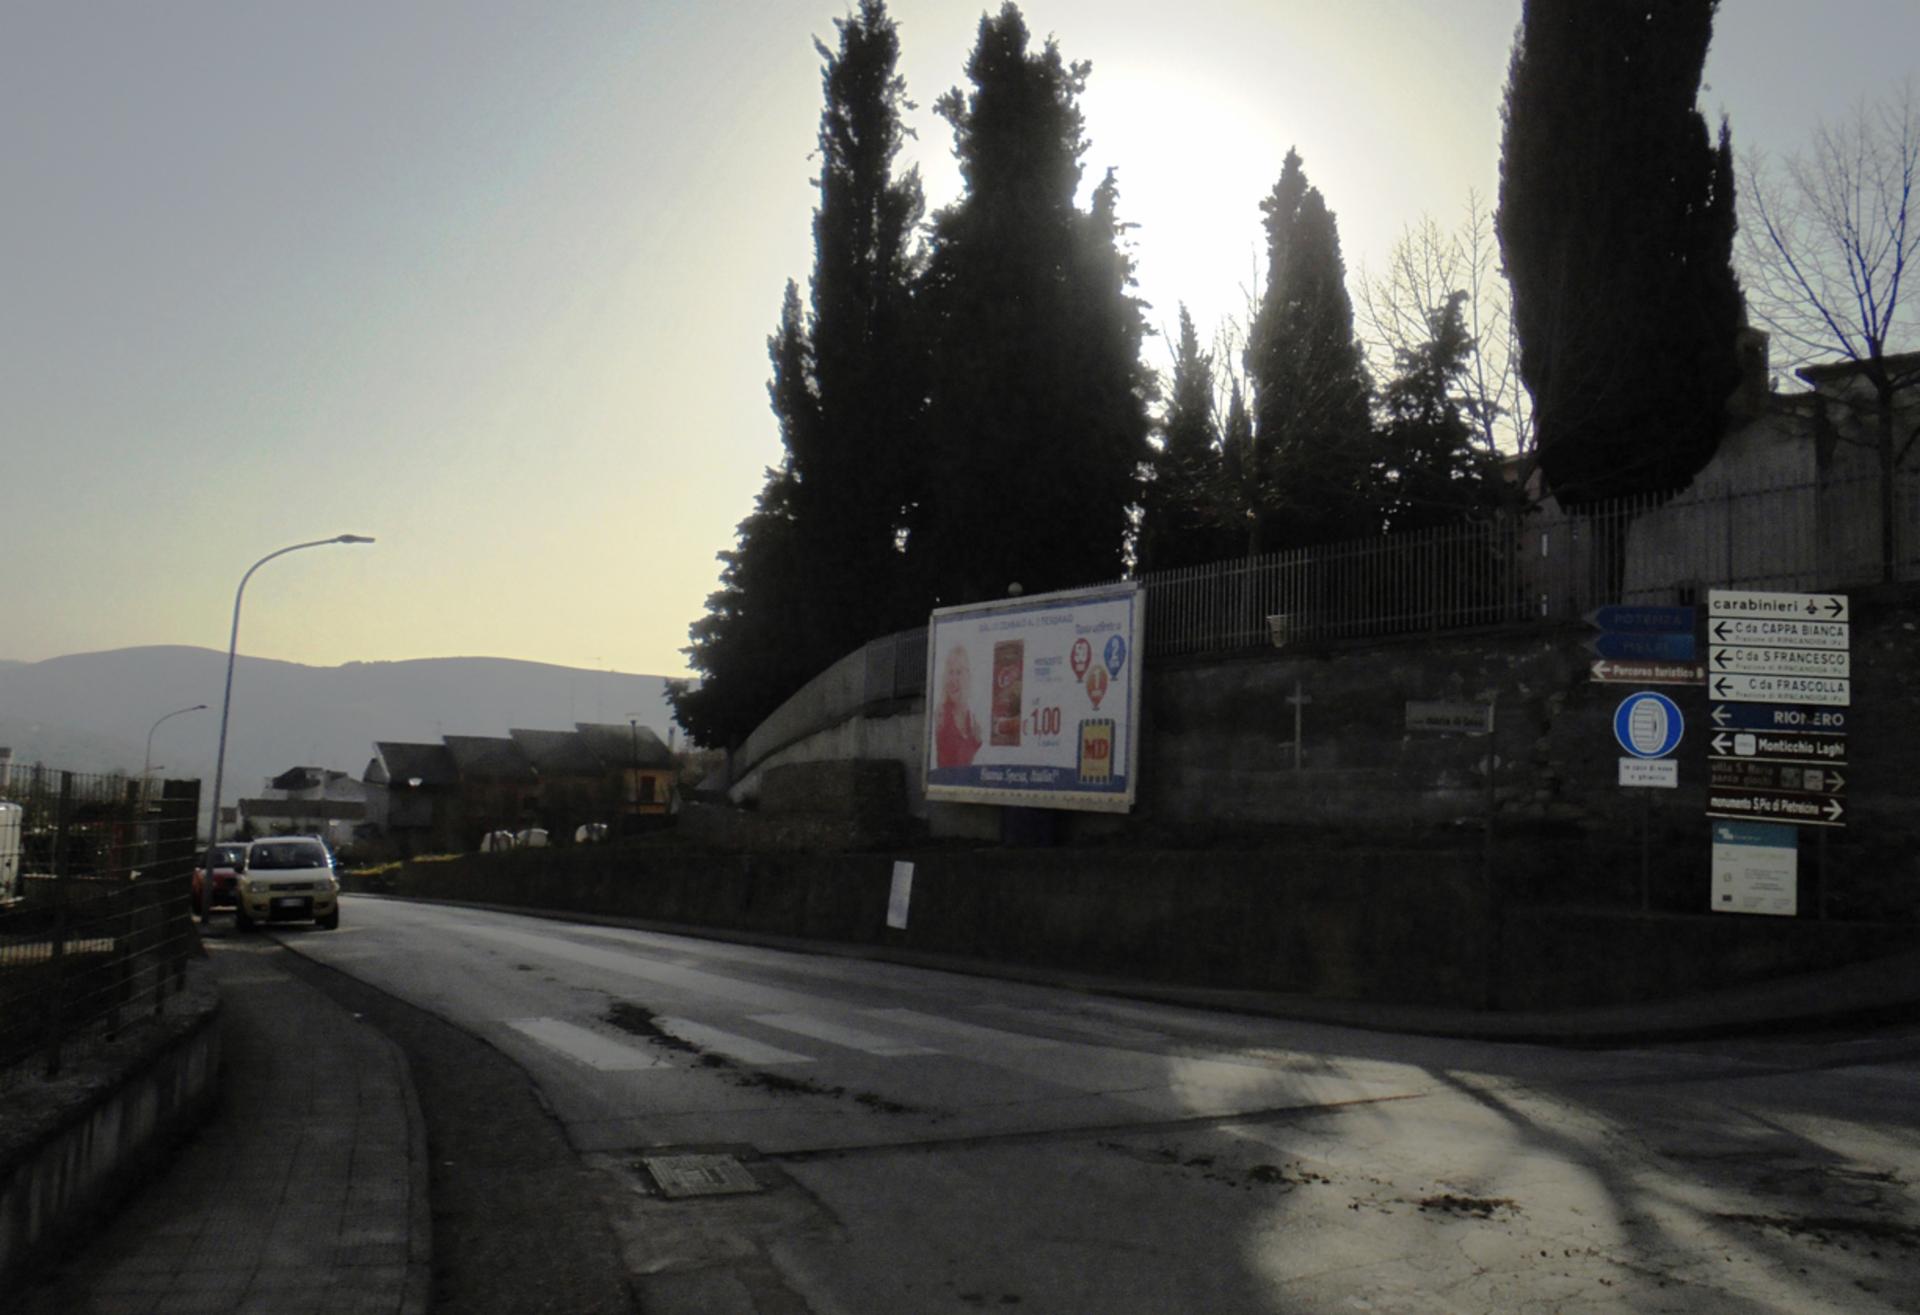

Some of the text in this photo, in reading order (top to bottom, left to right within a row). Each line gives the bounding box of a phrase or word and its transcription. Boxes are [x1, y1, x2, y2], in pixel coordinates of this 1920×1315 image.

[1713, 599, 1798, 612] carabinieri
[1762, 623, 1798, 635] CAPPA
[1802, 625, 1844, 637] BIANCA
[1111, 639, 1120, 660] 2
[1774, 653, 1845, 665] FRANCESCO
[1613, 664, 1653, 677] Percorso
[1777, 680, 1844, 693] FRASCOLLA
[1083, 738, 1108, 760] MD
[1758, 739, 1844, 757] Monticchio Laghi
